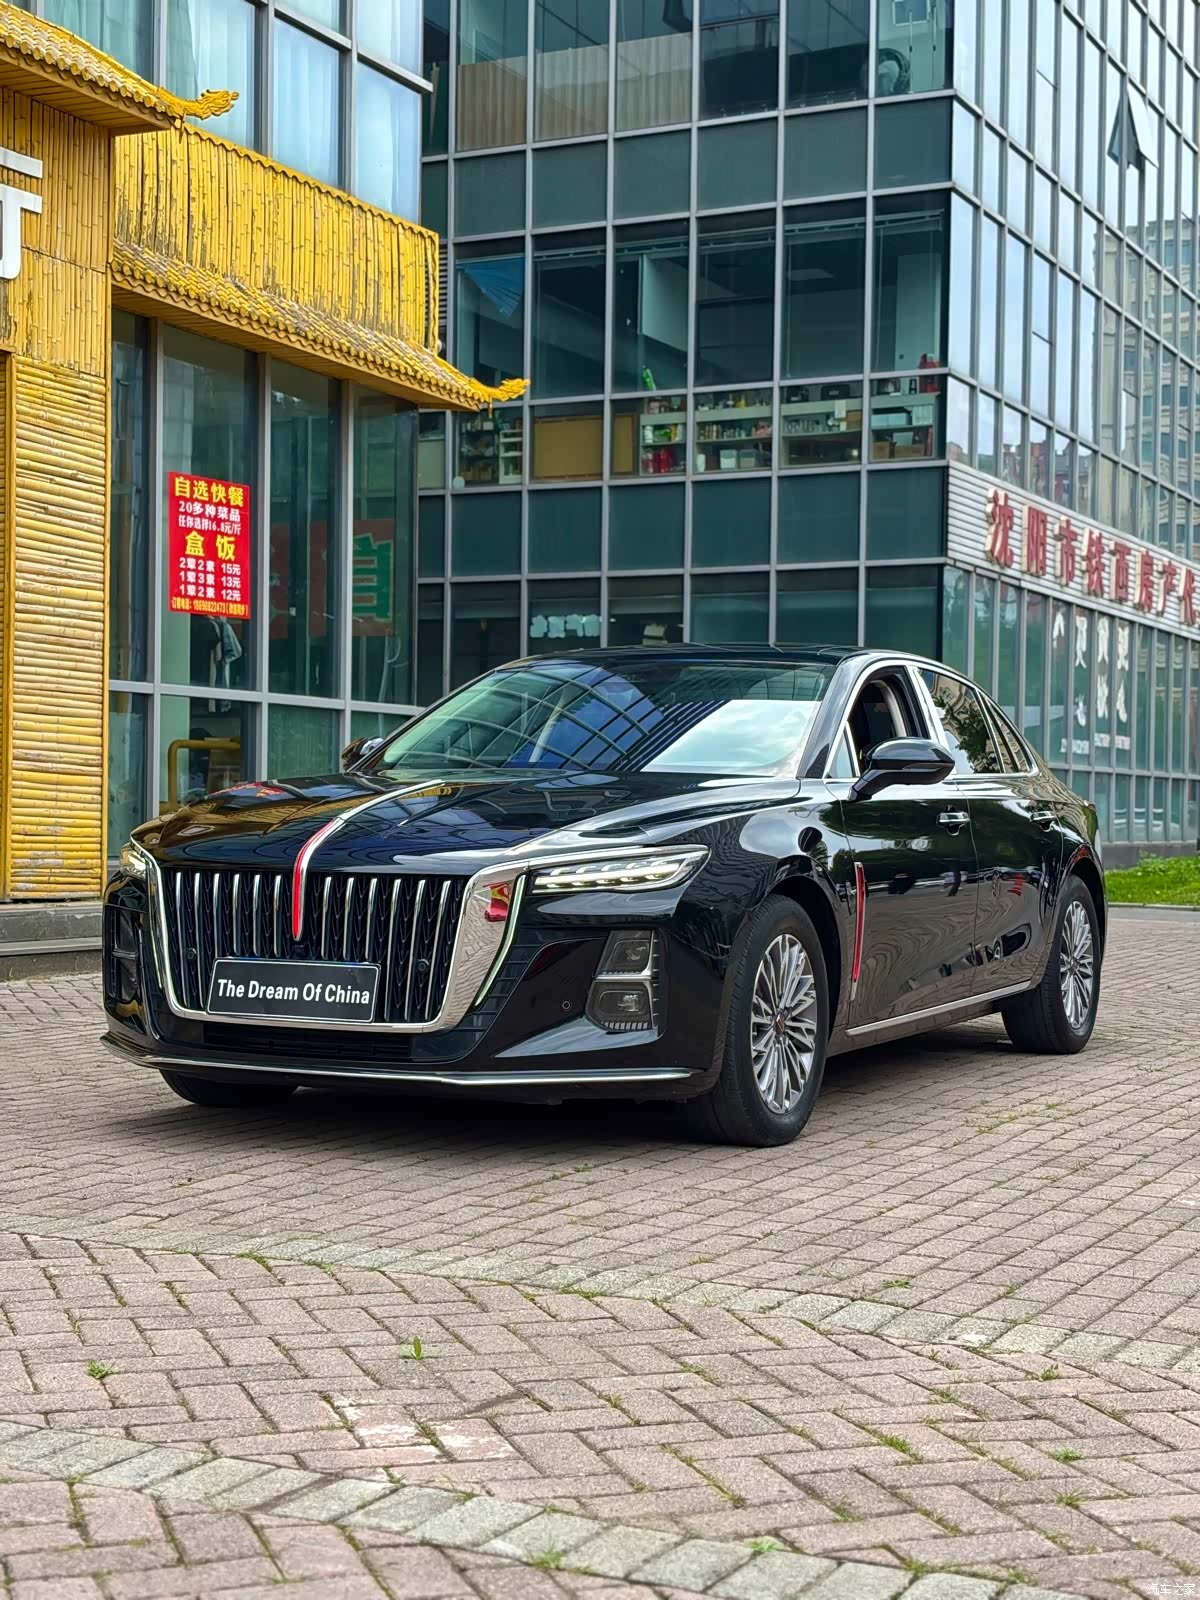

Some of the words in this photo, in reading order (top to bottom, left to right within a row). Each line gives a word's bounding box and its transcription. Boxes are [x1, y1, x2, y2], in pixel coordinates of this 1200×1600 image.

[175, 476, 244, 507] 自选快餐
[178, 501, 241, 522] 20多种菜品
[185, 530, 236, 561] 盒饭
[221, 562, 241, 576] 15元
[221, 576, 241, 589] 13元
[221, 589, 241, 602] 12元
[217, 979, 245, 998] The
[248, 981, 299, 1000] Dream
[302, 982, 322, 1001] Of
[324, 984, 370, 1004] China
